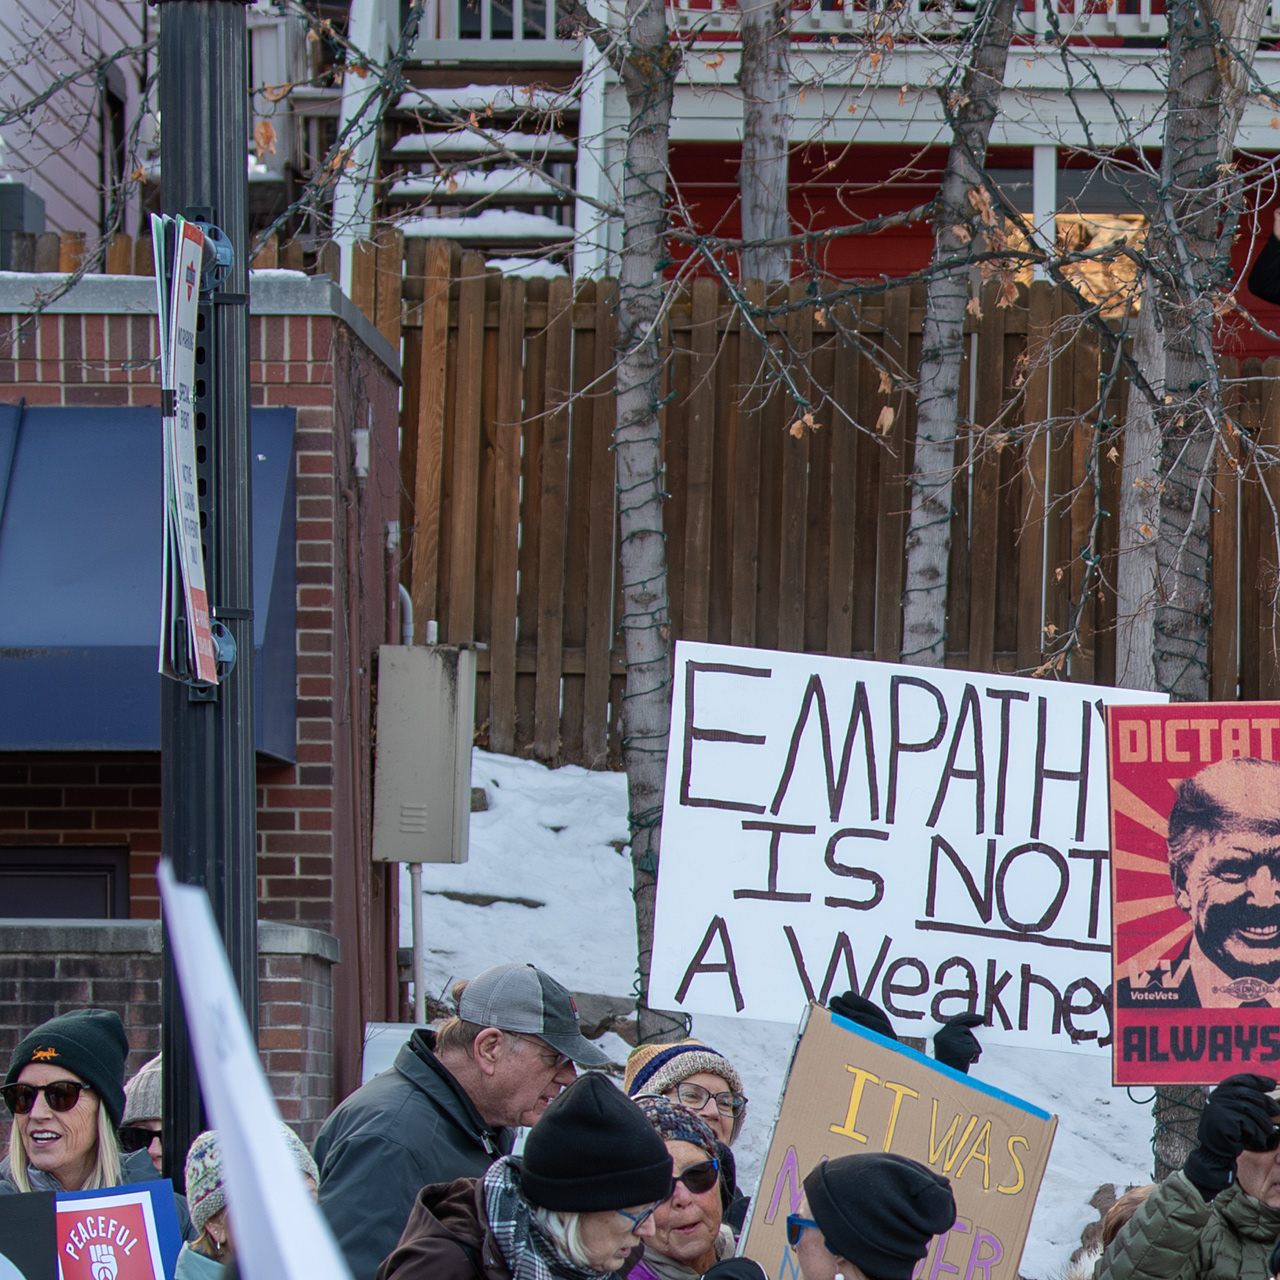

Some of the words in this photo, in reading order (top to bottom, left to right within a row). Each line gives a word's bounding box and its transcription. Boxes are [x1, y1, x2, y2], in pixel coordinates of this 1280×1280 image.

[680, 658, 1107, 841] EMPATH
[733, 820, 889, 910] IS
[924, 834, 1110, 939] NOT
[674, 914, 745, 1012] A
[1130, 990, 1179, 1000] VoteVets
[1122, 1025, 1280, 1062] ALWAYS
[829, 1063, 921, 1153] IT
[928, 1098, 1030, 1196] WAS
[65, 1215, 138, 1261] PEACEFUL
